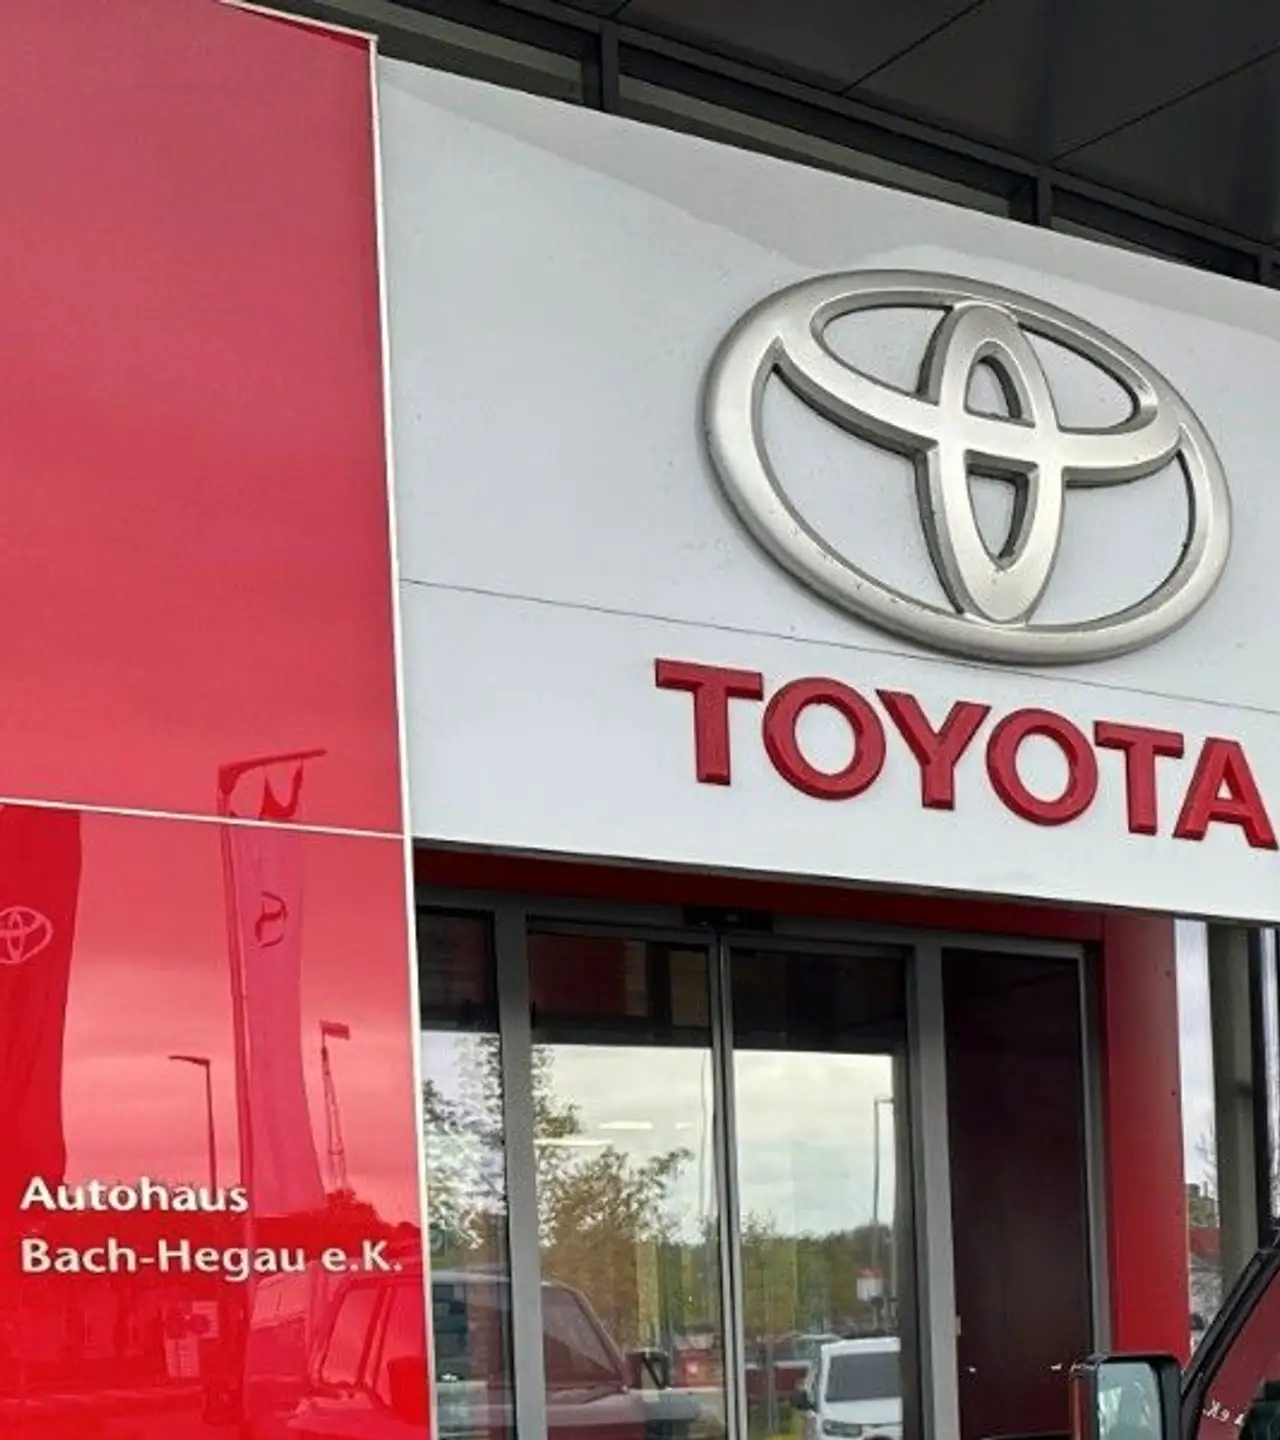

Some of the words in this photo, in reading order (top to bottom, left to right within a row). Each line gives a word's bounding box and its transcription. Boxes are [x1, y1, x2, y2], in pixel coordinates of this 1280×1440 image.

[654, 657, 1280, 851] TOYOTA
[19, 1175, 249, 1213] Autohaus
[20, 1237, 306, 1282] Bach-Hegau
[321, 1240, 403, 1273] e.K.
